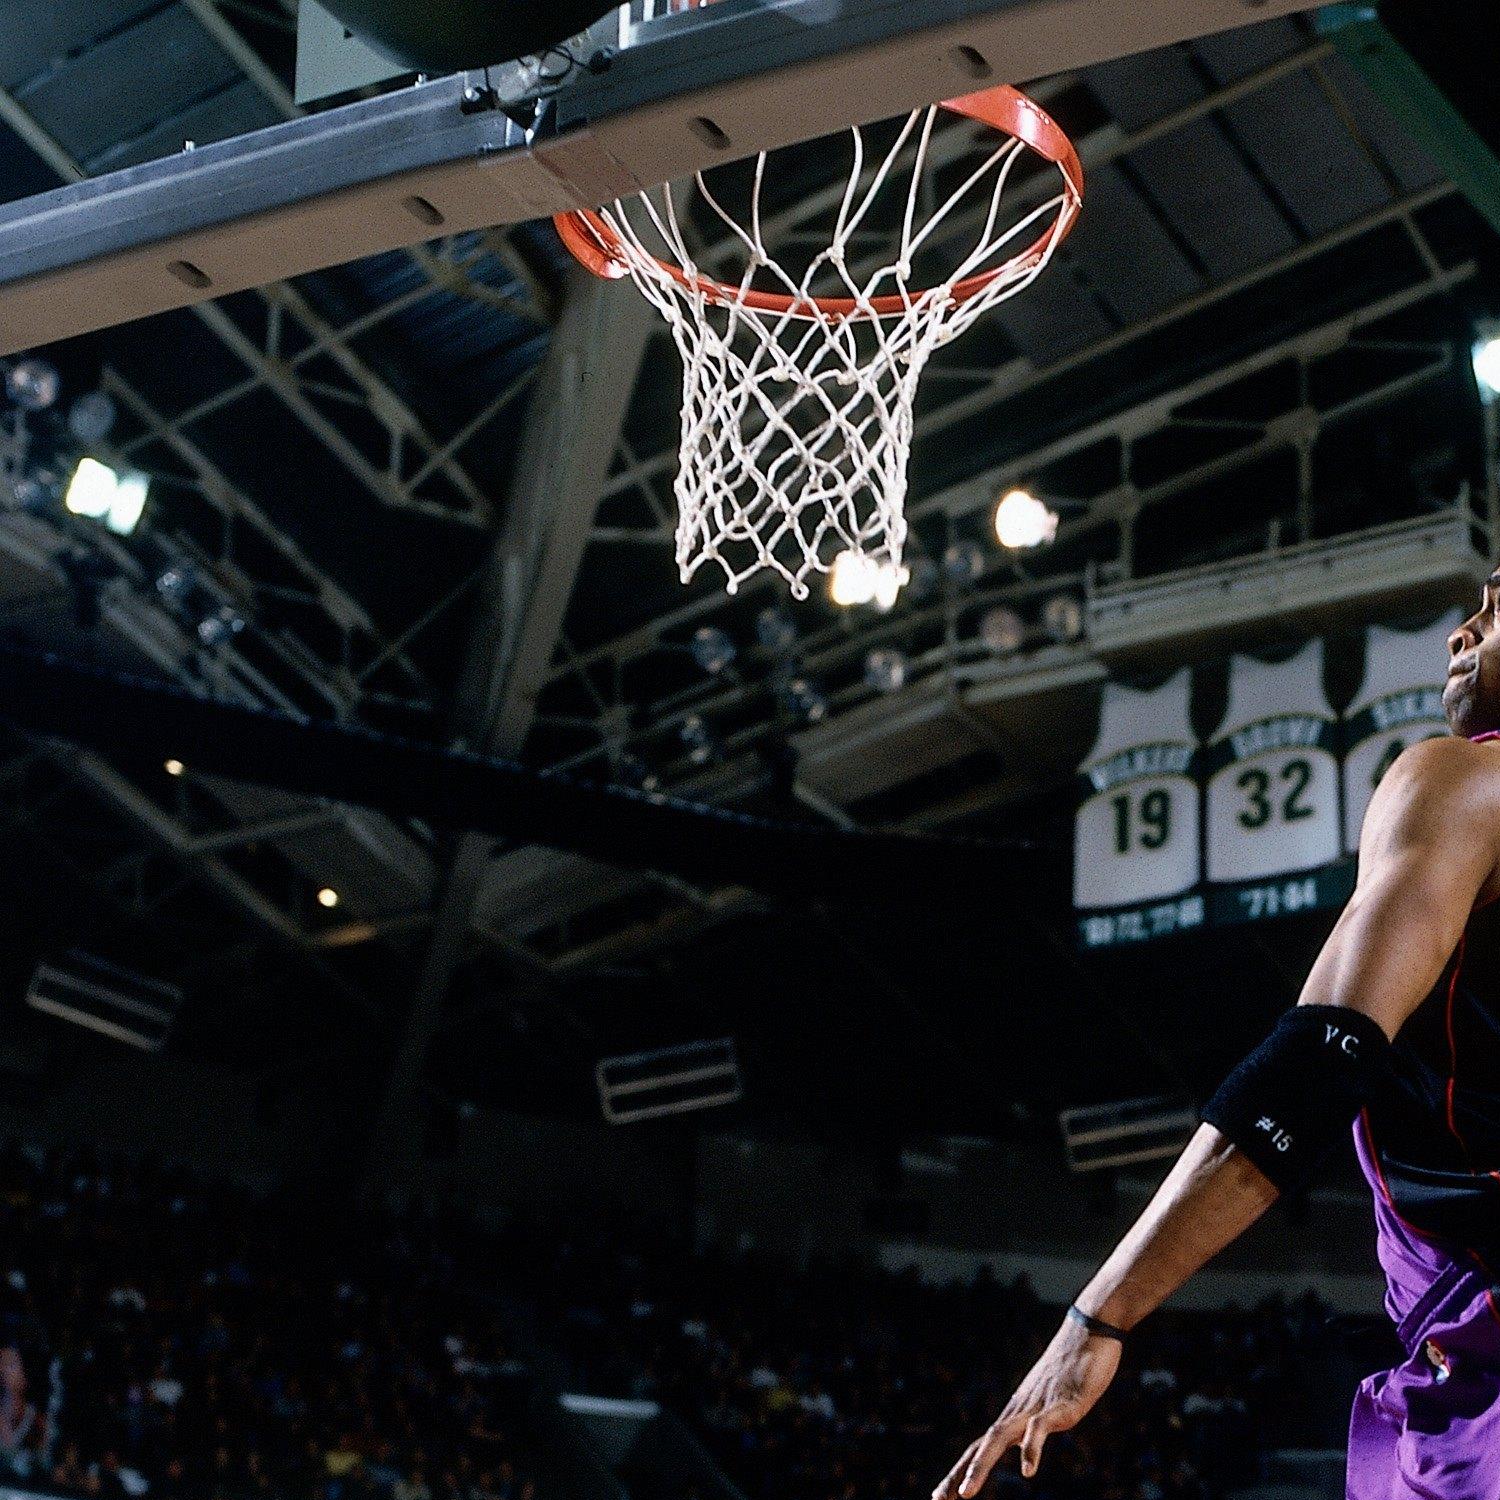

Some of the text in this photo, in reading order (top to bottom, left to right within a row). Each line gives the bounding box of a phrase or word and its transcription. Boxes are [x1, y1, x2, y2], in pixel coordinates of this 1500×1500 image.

[1110, 788, 1171, 853] 19
[1236, 759, 1315, 829] 32
[1255, 1116, 1293, 1151] #15
